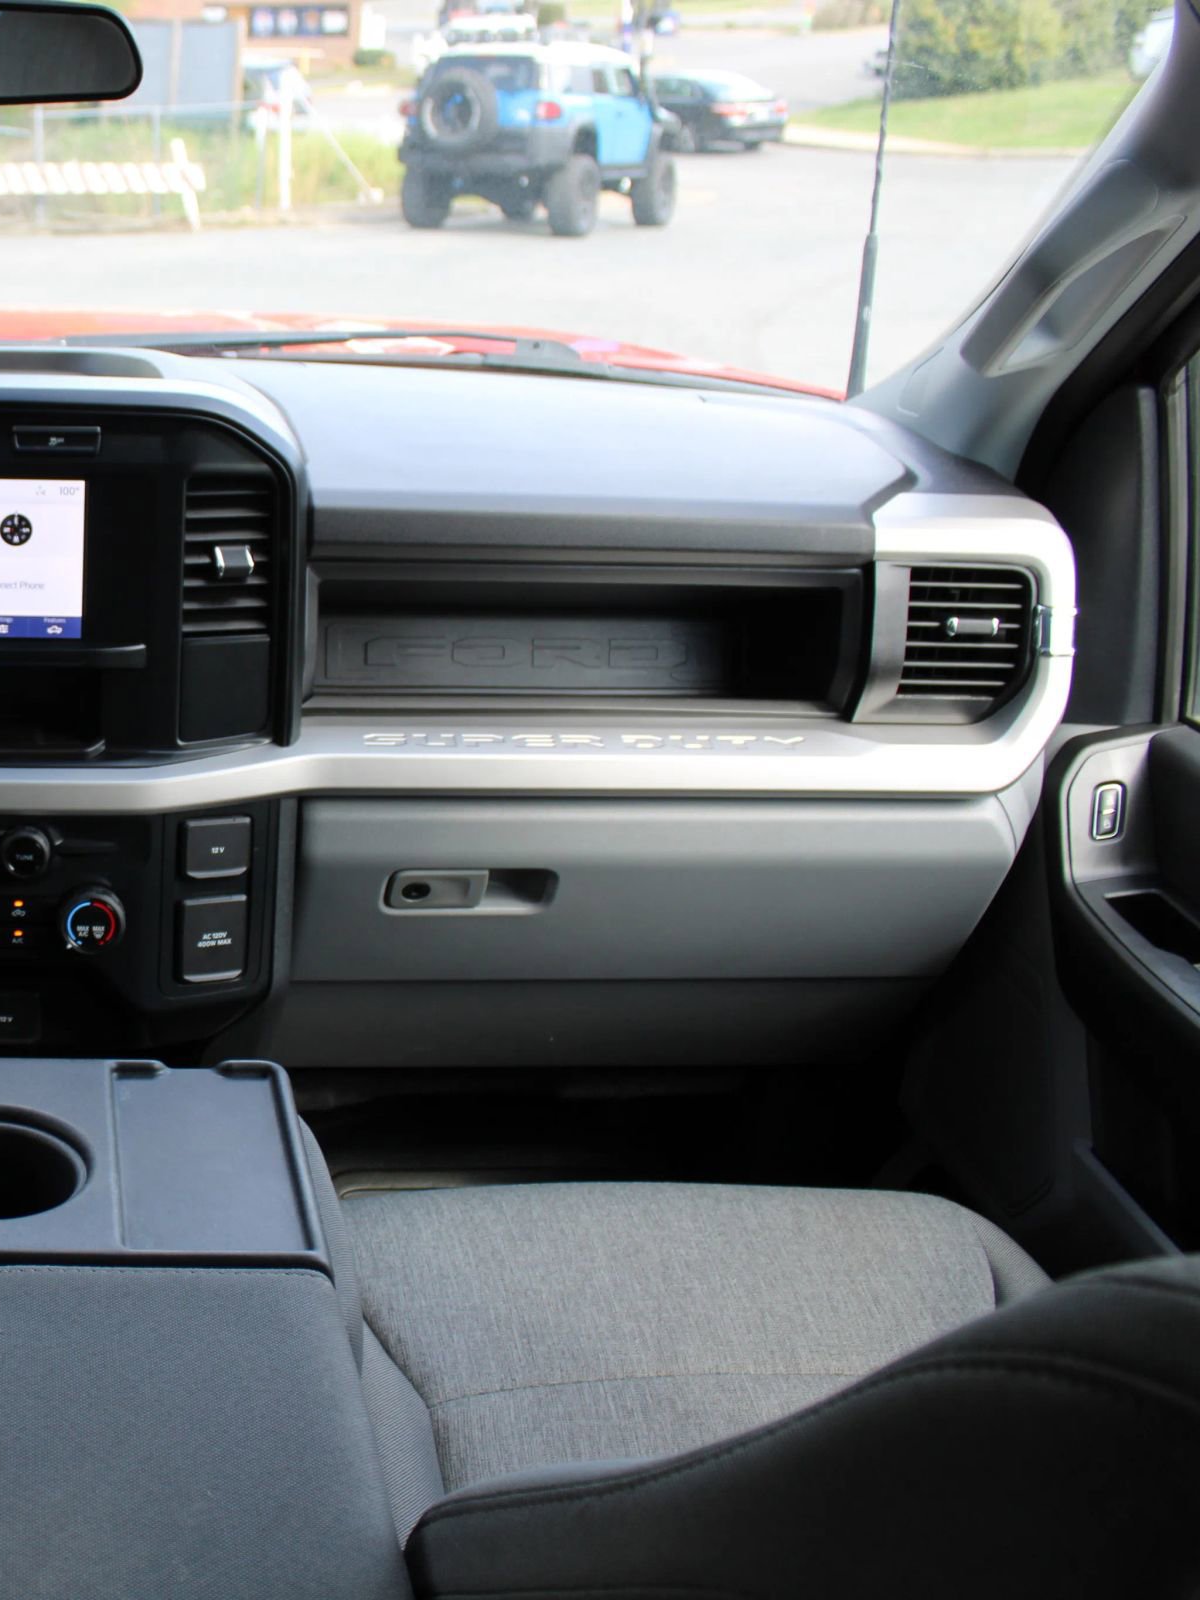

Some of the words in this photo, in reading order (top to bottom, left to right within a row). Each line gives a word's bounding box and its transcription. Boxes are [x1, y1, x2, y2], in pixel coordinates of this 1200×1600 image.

[19, 580, 46, 591] Phone
[364, 636, 689, 670] FORD
[363, 733, 606, 748] SUPER
[621, 733, 806, 749] DUTY
